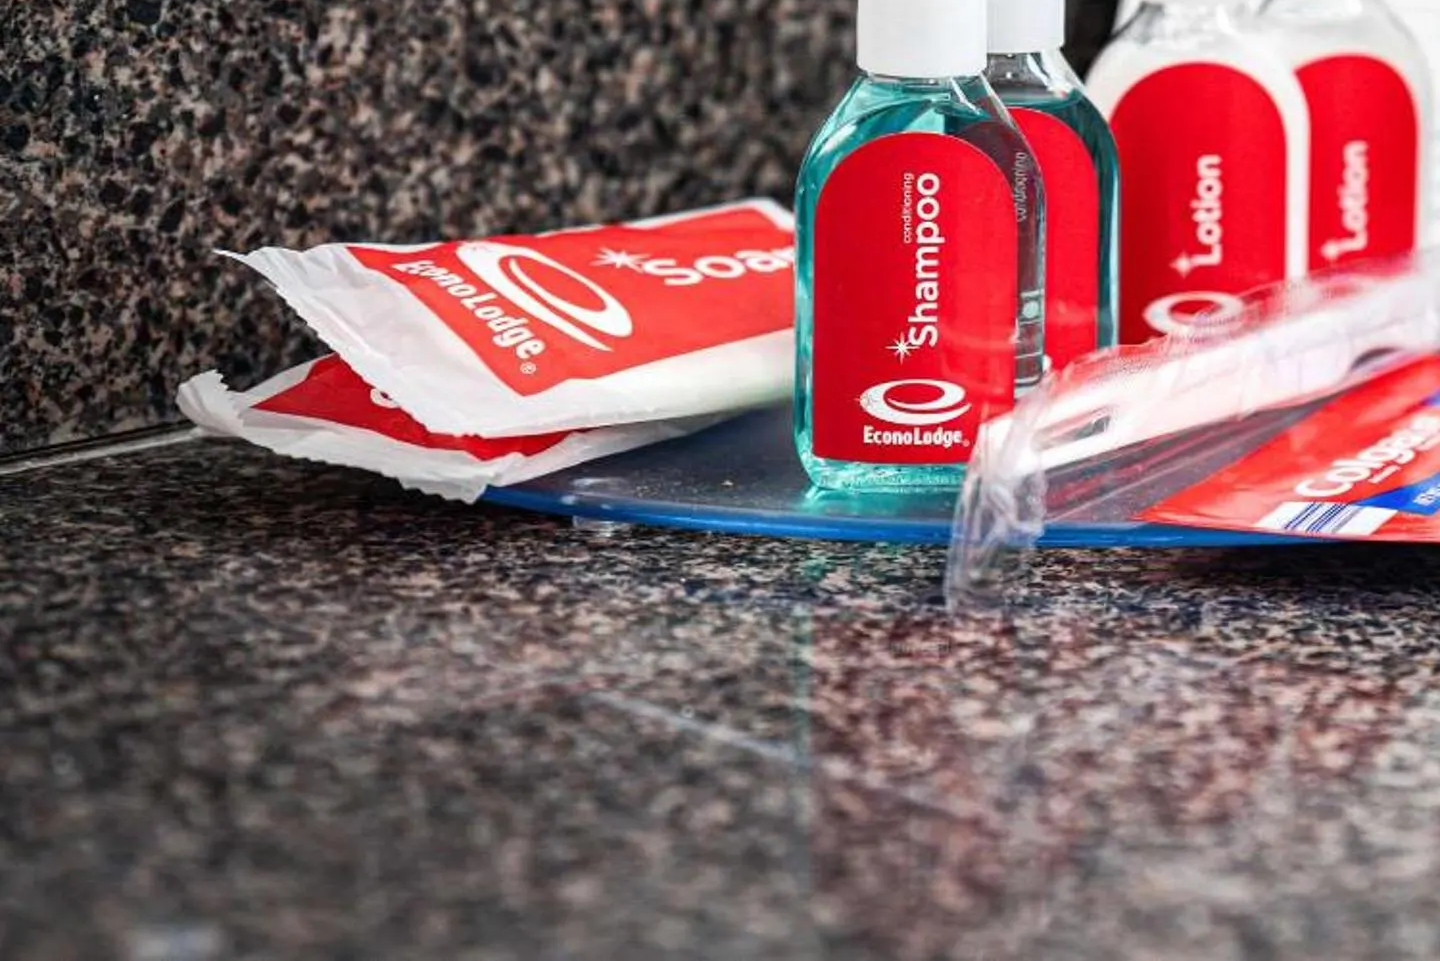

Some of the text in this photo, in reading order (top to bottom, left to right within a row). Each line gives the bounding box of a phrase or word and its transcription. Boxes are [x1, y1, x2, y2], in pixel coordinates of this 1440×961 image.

[903, 172, 915, 244] conditioning
[1189, 154, 1222, 265] Lotion
[1334, 140, 1368, 251] Lotion
[907, 172, 945, 348] Shampoo
[863, 424, 962, 448] EconoLodge
